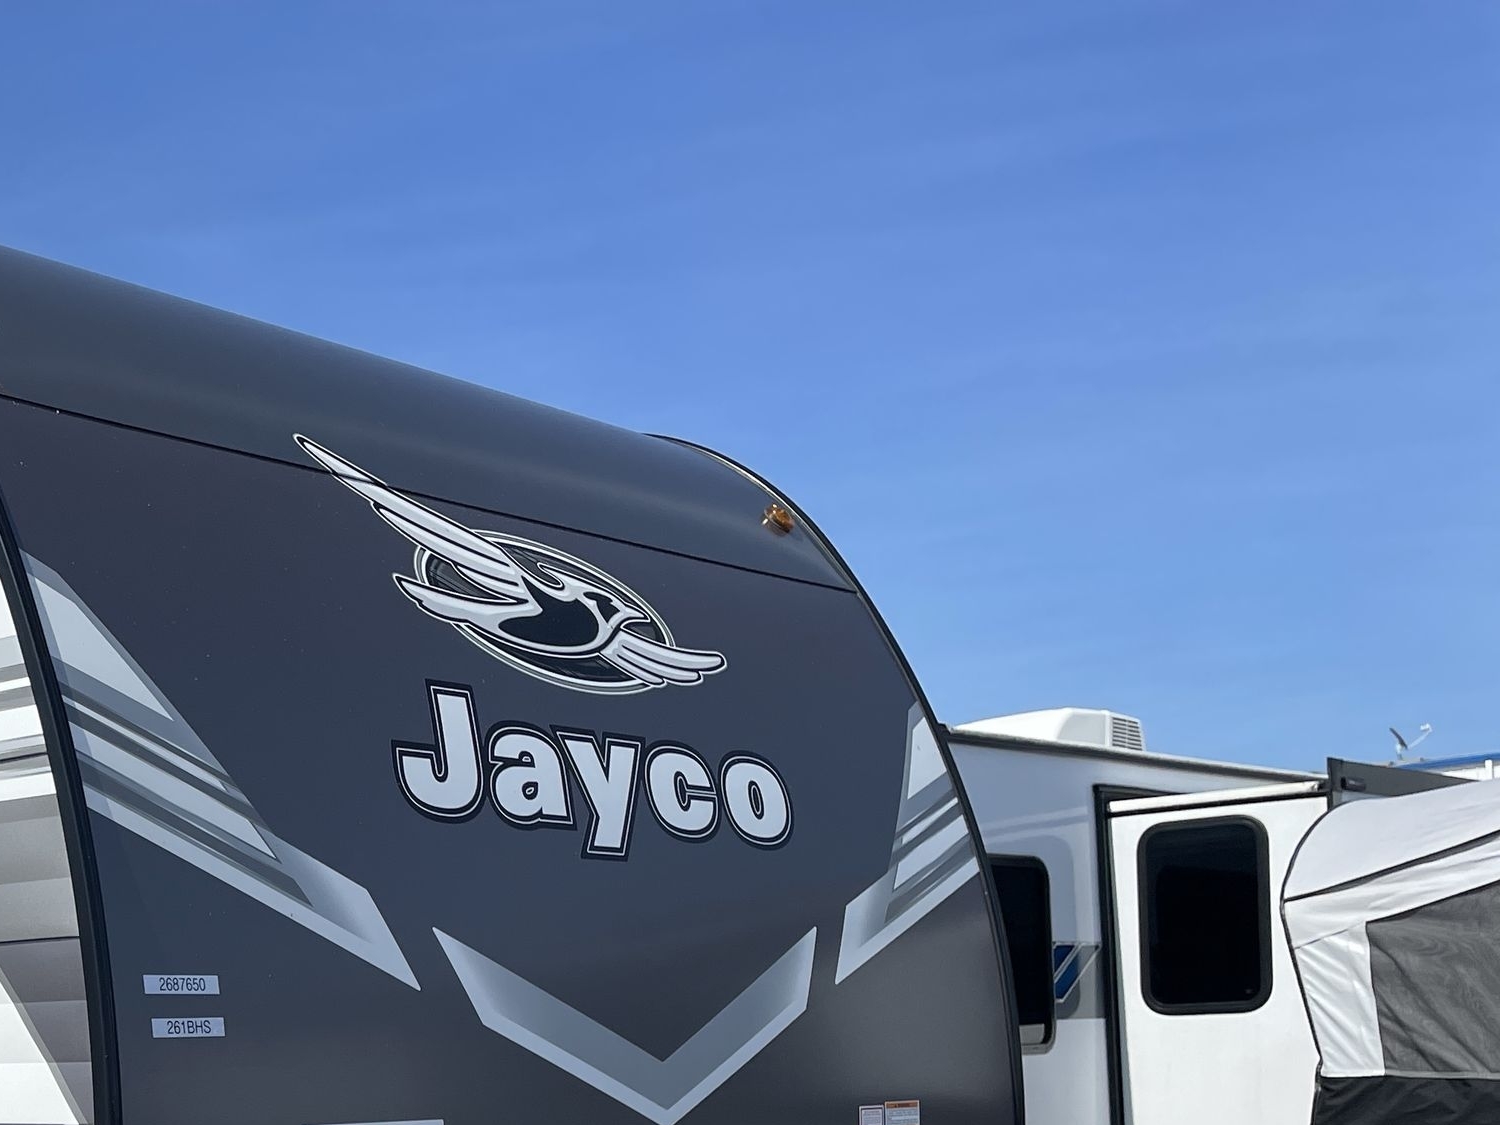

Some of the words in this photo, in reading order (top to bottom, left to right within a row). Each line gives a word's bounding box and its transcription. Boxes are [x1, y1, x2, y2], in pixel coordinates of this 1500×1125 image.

[391, 680, 792, 859] Jayco
[159, 977, 206, 991] 2687650
[167, 1020, 212, 1034] 261BHS
